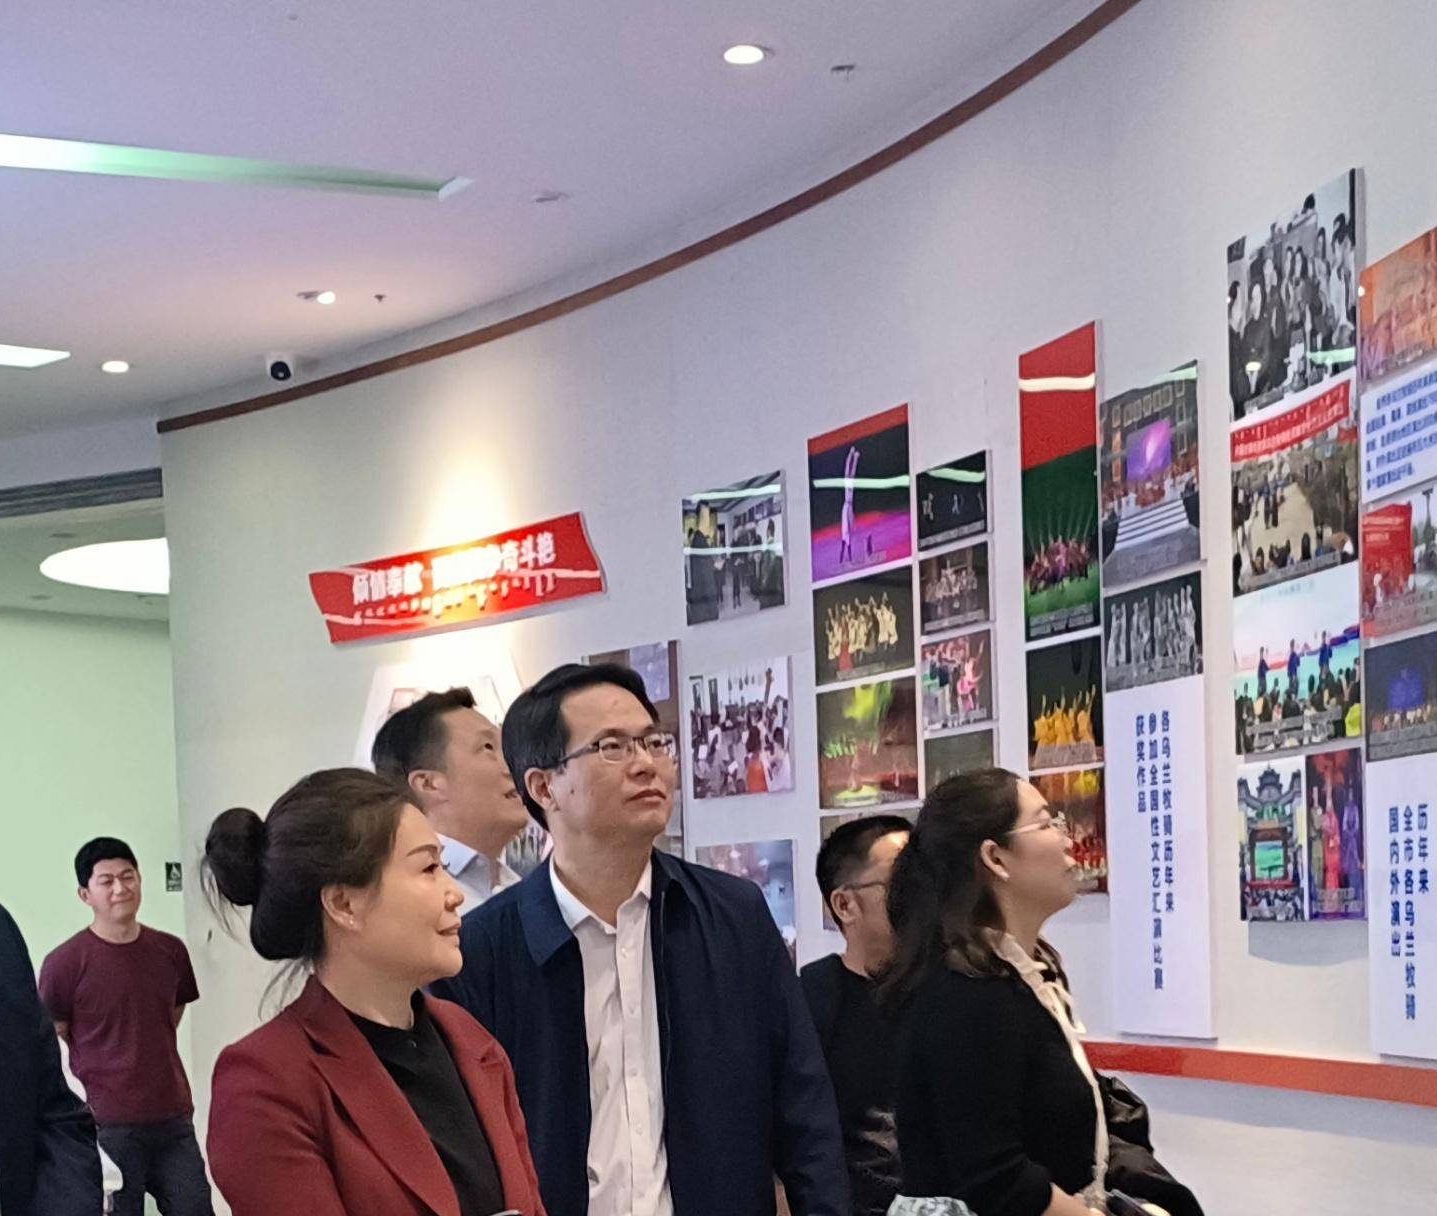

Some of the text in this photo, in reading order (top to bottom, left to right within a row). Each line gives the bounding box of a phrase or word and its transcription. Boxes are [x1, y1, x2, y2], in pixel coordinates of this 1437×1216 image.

[1136, 714, 1147, 813] 获奖作品
[1148, 712, 1163, 990] 参加全国性文艺汇演比赛
[1161, 710, 1175, 913] 各乌兰牧骑历年来
[1417, 803, 1429, 893] 历年来
[1403, 805, 1415, 1020] 全市各乌兰牧骑
